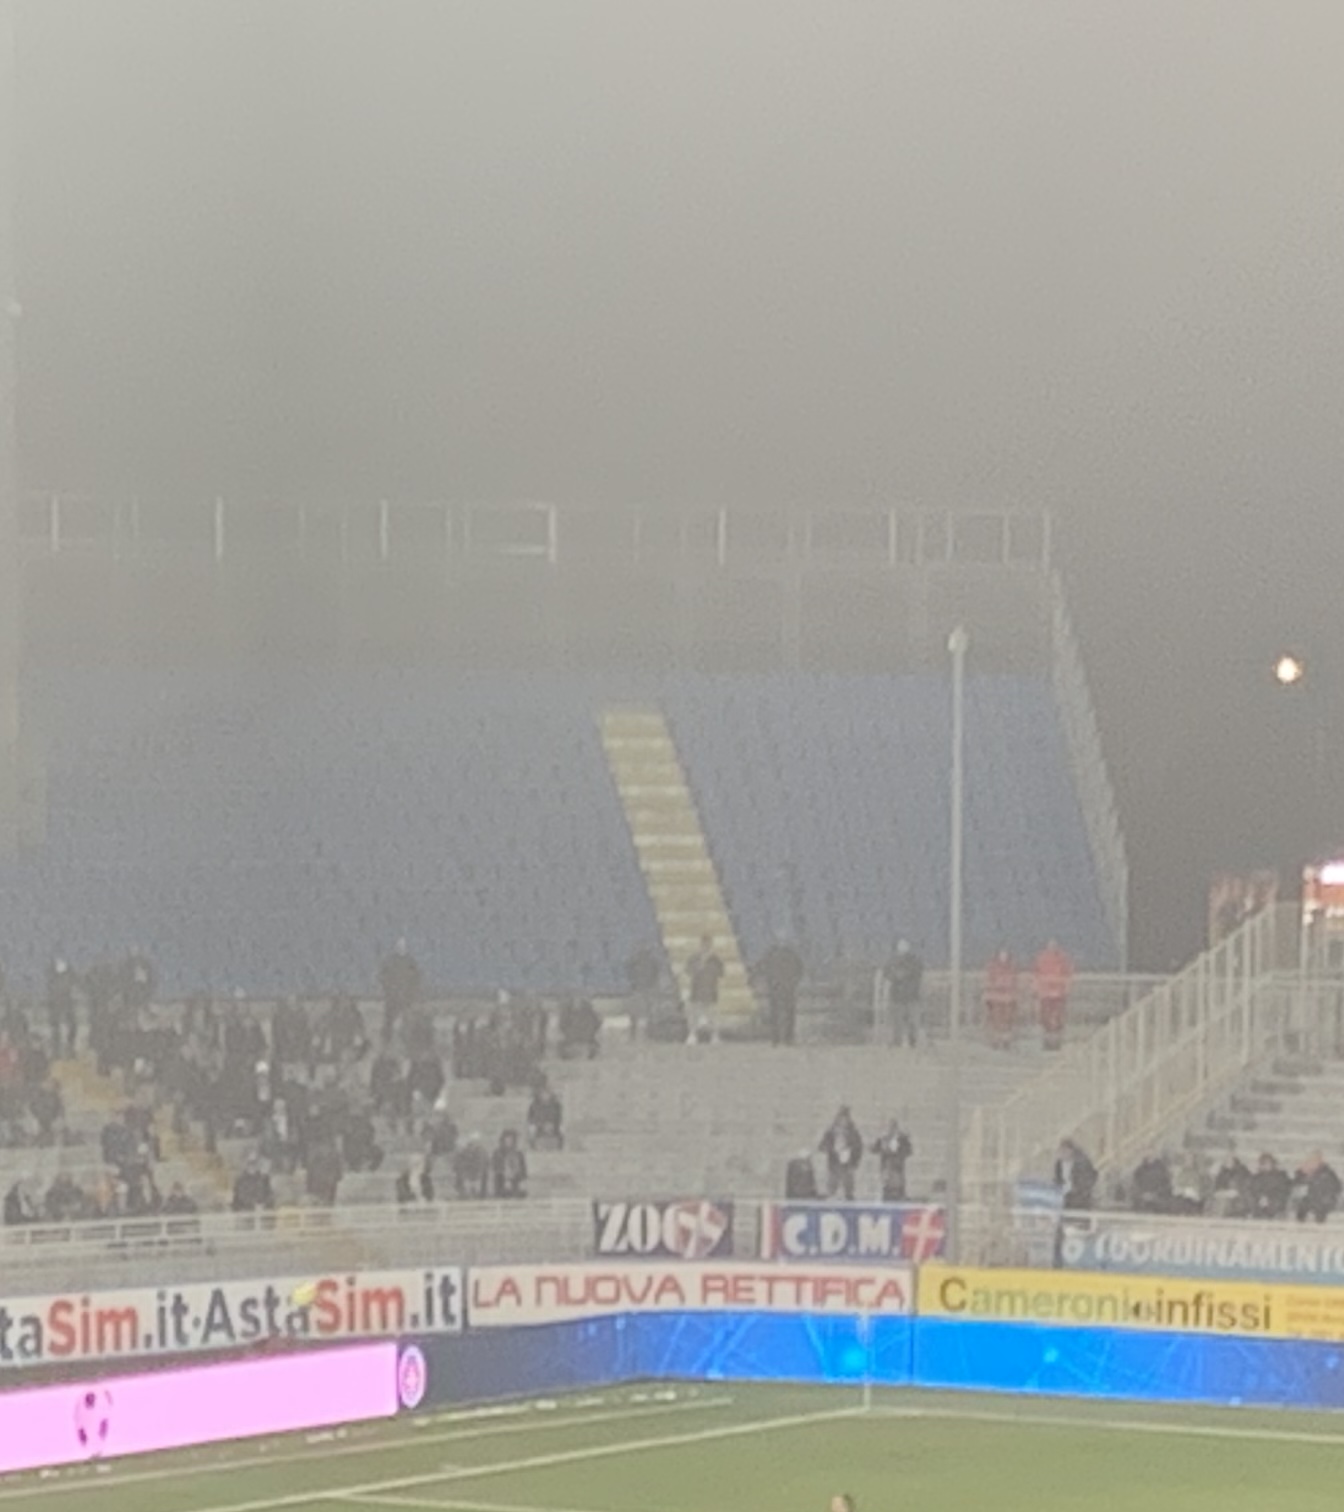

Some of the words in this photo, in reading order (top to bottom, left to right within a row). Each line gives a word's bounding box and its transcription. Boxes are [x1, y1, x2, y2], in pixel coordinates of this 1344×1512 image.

[472, 1274, 523, 1309] LA
[535, 1273, 679, 1308] NUOVA
[699, 1273, 906, 1309] RETTIFICA
